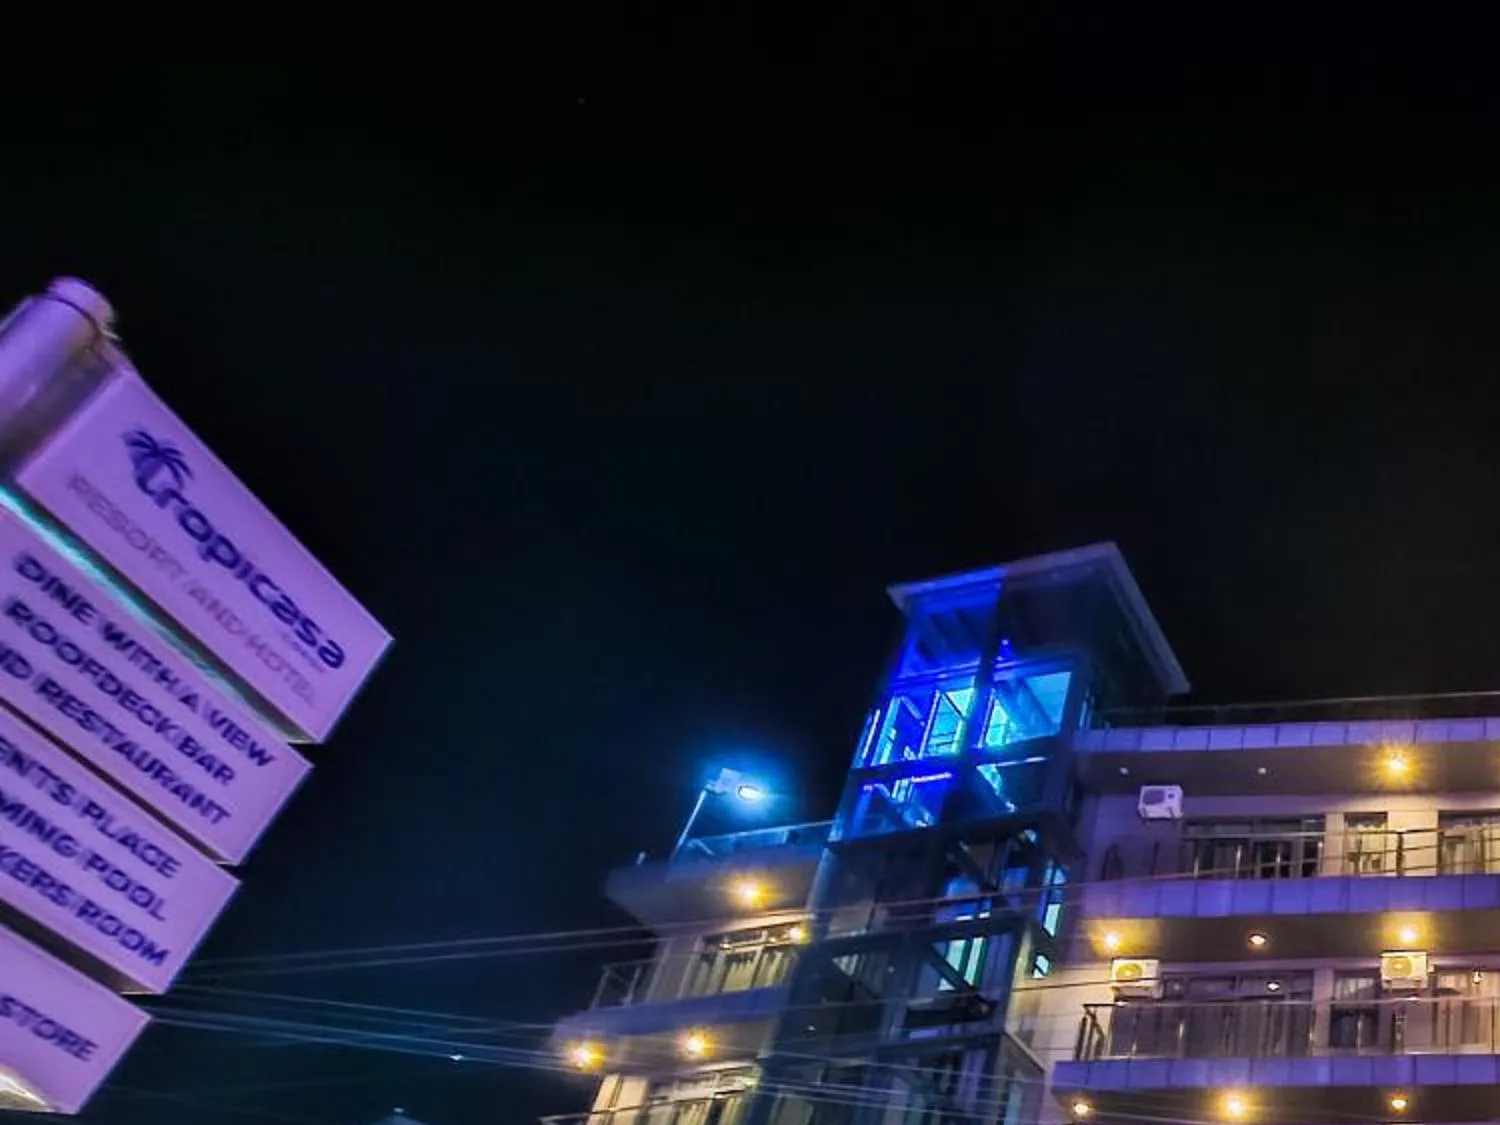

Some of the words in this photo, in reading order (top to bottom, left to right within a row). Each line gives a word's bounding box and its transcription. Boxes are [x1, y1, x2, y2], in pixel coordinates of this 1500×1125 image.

[187, 584, 247, 635] AND
[14, 553, 98, 626] DINE
[102, 619, 181, 692] WITH
[207, 707, 277, 767] VIEW
[35, 674, 232, 826] RESTAURANT
[178, 733, 236, 786] BAR
[81, 798, 182, 879] PLACE
[82, 852, 166, 921] POOL
[76, 898, 170, 967] ROOM
